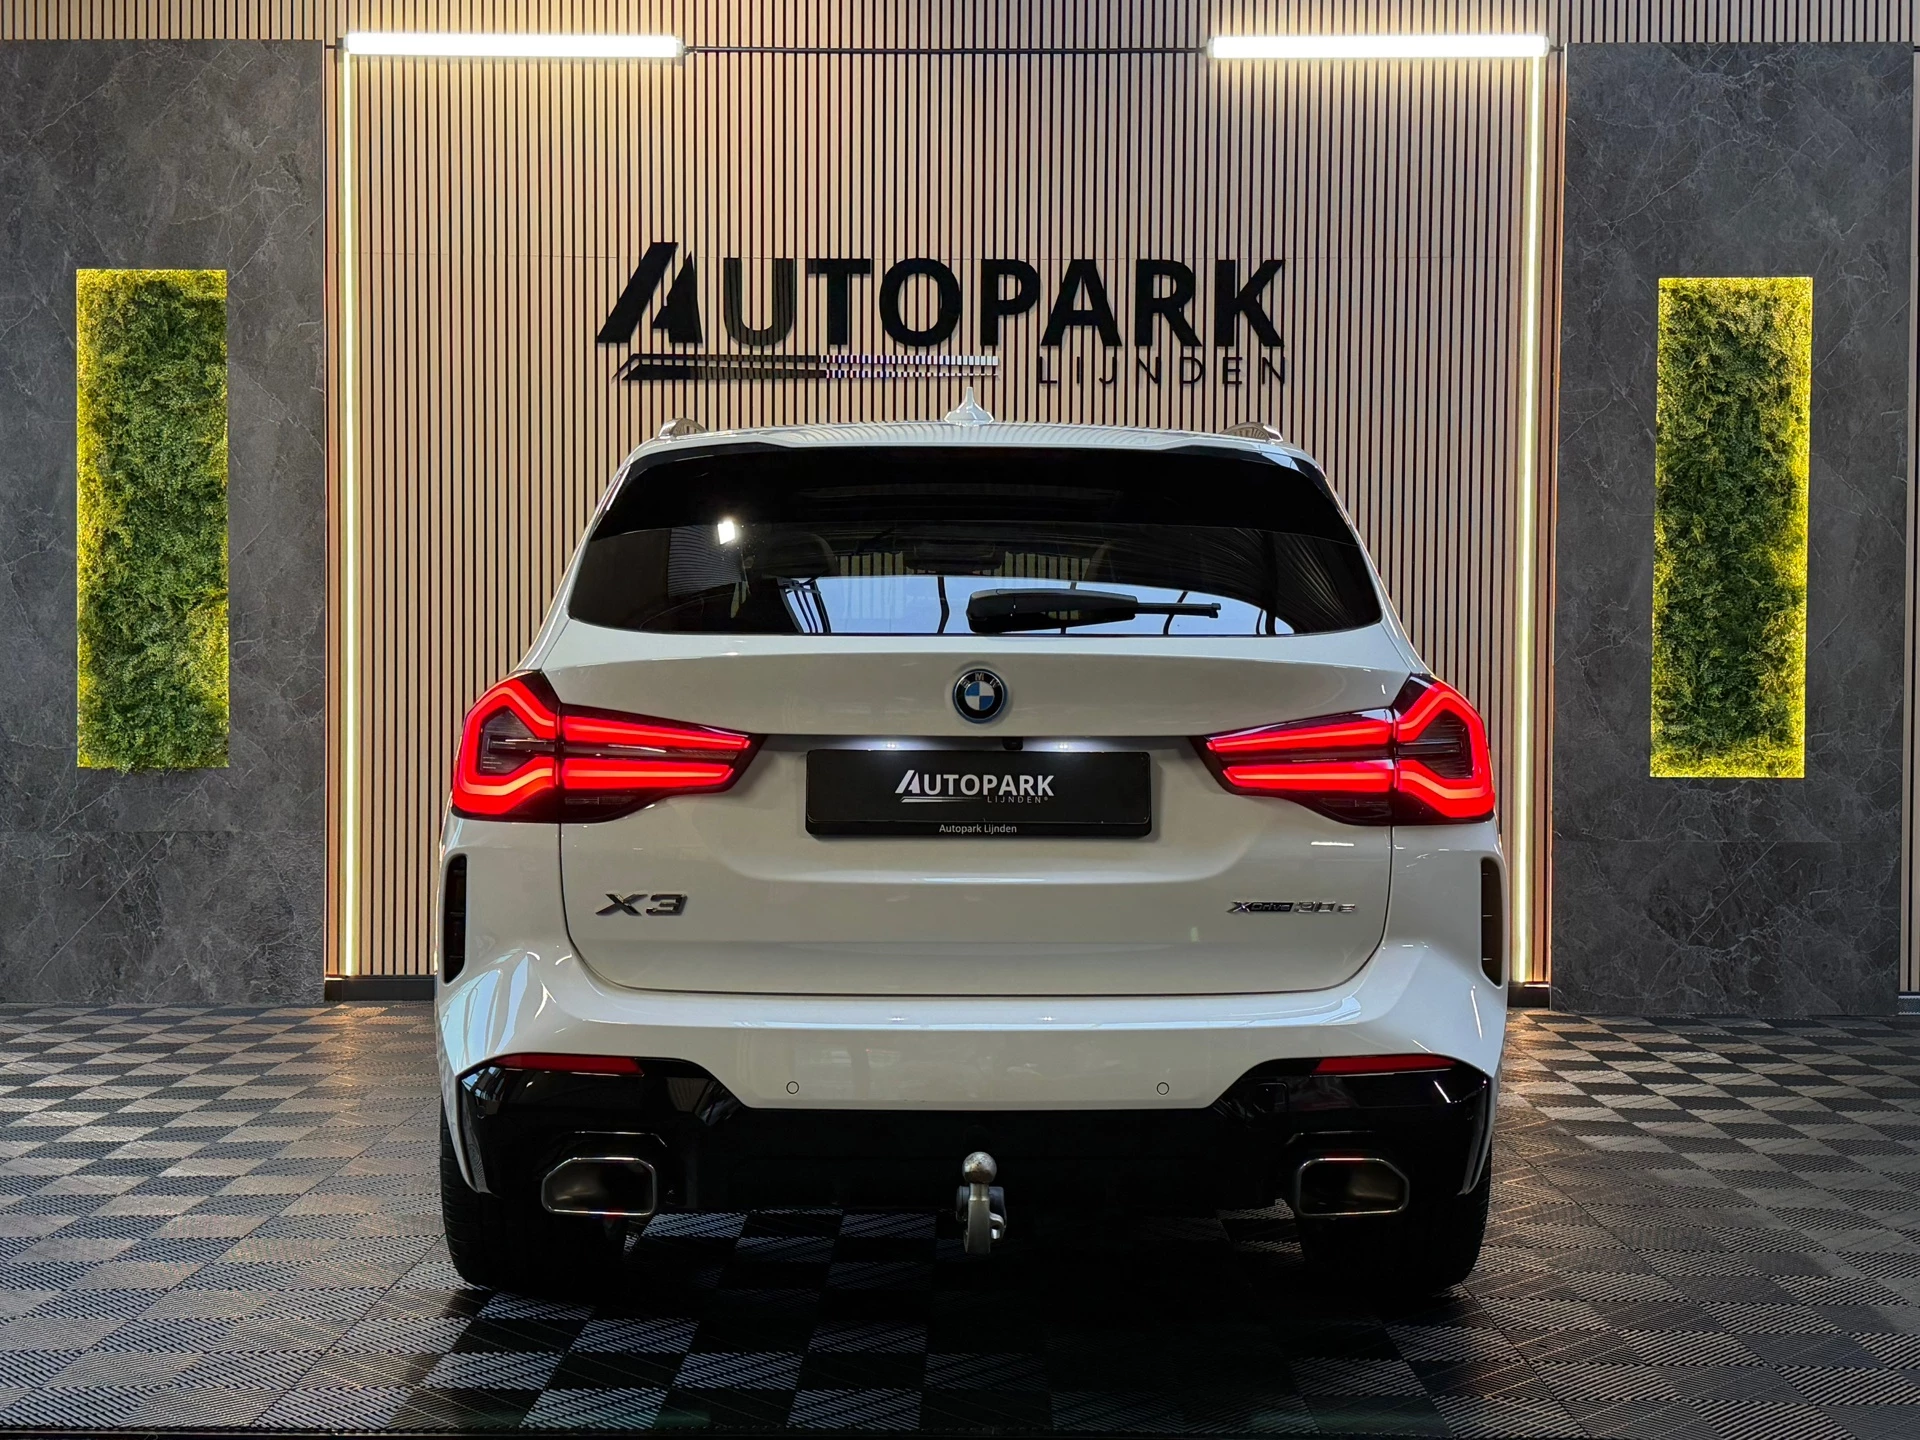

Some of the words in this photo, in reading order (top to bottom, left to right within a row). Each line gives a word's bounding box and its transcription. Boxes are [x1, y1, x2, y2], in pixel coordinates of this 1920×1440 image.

[597, 241, 1285, 348] AUTOPARK
[1039, 356, 1286, 385] LIJNDEN
[894, 769, 1055, 796] AUTOPARK
[938, 824, 982, 834] Autopark
[983, 824, 1017, 834] Lijnden
[595, 893, 689, 917] X3
